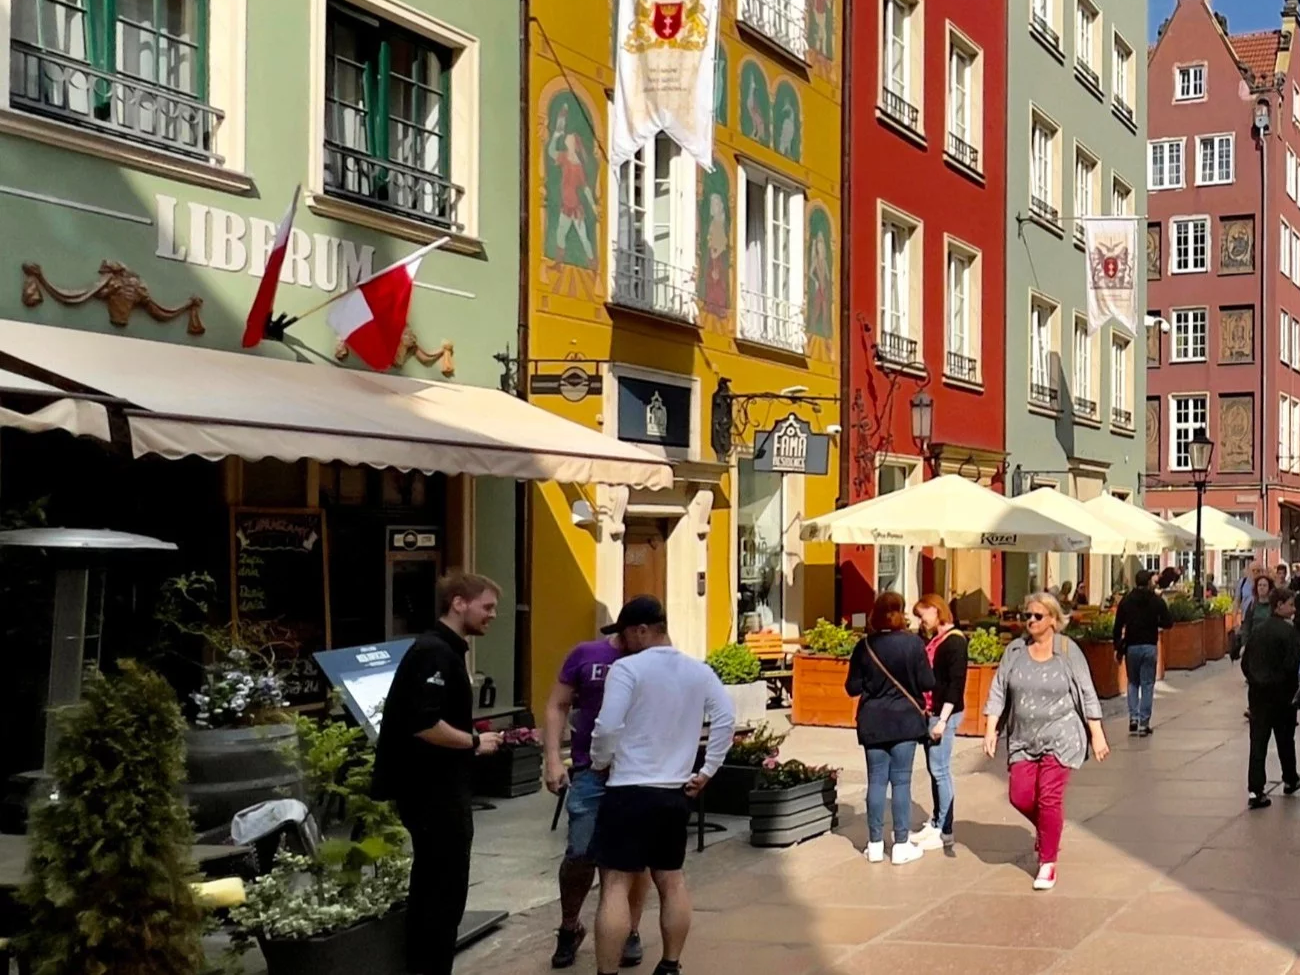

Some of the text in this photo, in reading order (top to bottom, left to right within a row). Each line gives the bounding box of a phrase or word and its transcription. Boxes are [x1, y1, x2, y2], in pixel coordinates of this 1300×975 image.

[155, 193, 376, 294] LIBERUM
[773, 432, 807, 457] FAMA
[980, 532, 1017, 546] Kozel
